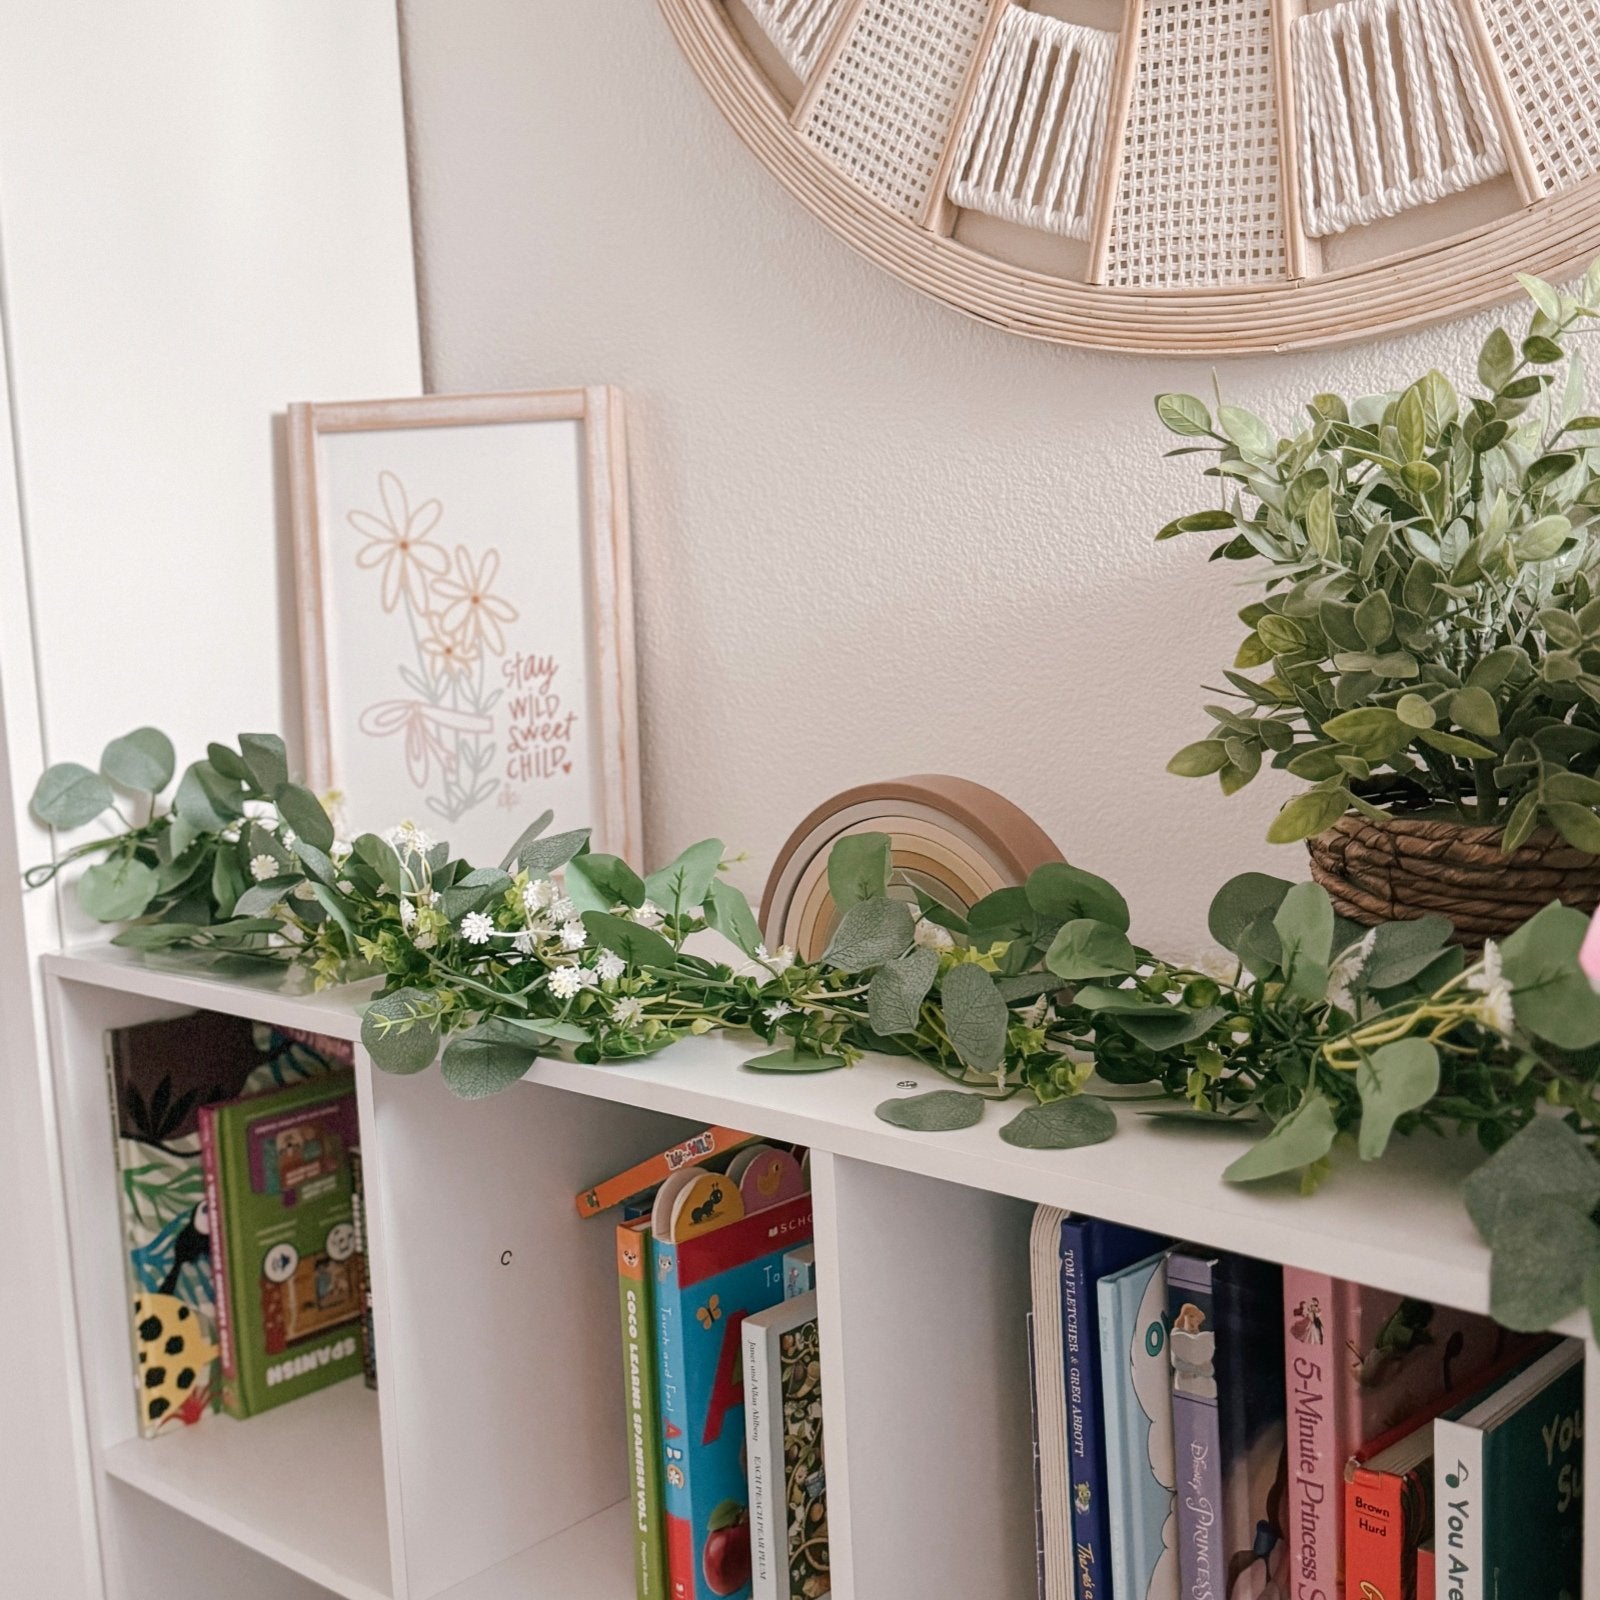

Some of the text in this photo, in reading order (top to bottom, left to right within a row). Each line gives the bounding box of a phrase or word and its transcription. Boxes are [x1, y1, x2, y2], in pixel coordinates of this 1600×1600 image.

[626, 1290, 638, 1338] COCO
[660, 1307, 672, 1345] Touch
[266, 1337, 356, 1387] SPANISH
[662, 1351, 673, 1379] and
[748, 1340, 756, 1363] Janet
[1064, 1249, 1084, 1458] TOM FLETCHER & GREG ABBOTT
[629, 1343, 642, 1410] LEARNS
[750, 1365, 758, 1383] and
[665, 1384, 677, 1412] Feel
[1293, 1357, 1323, 1474] 5-Minute
[632, 1413, 645, 1489] SPANISH
[754, 1456, 762, 1484] EACH
[755, 1486, 763, 1520] PEACH
[1355, 1496, 1390, 1518] Brown
[1296, 1476, 1324, 1581] Princess
[1359, 1518, 1387, 1537] Hurd
[1077, 1543, 1095, 1588] There's
[1447, 1500, 1470, 1600] You Are
